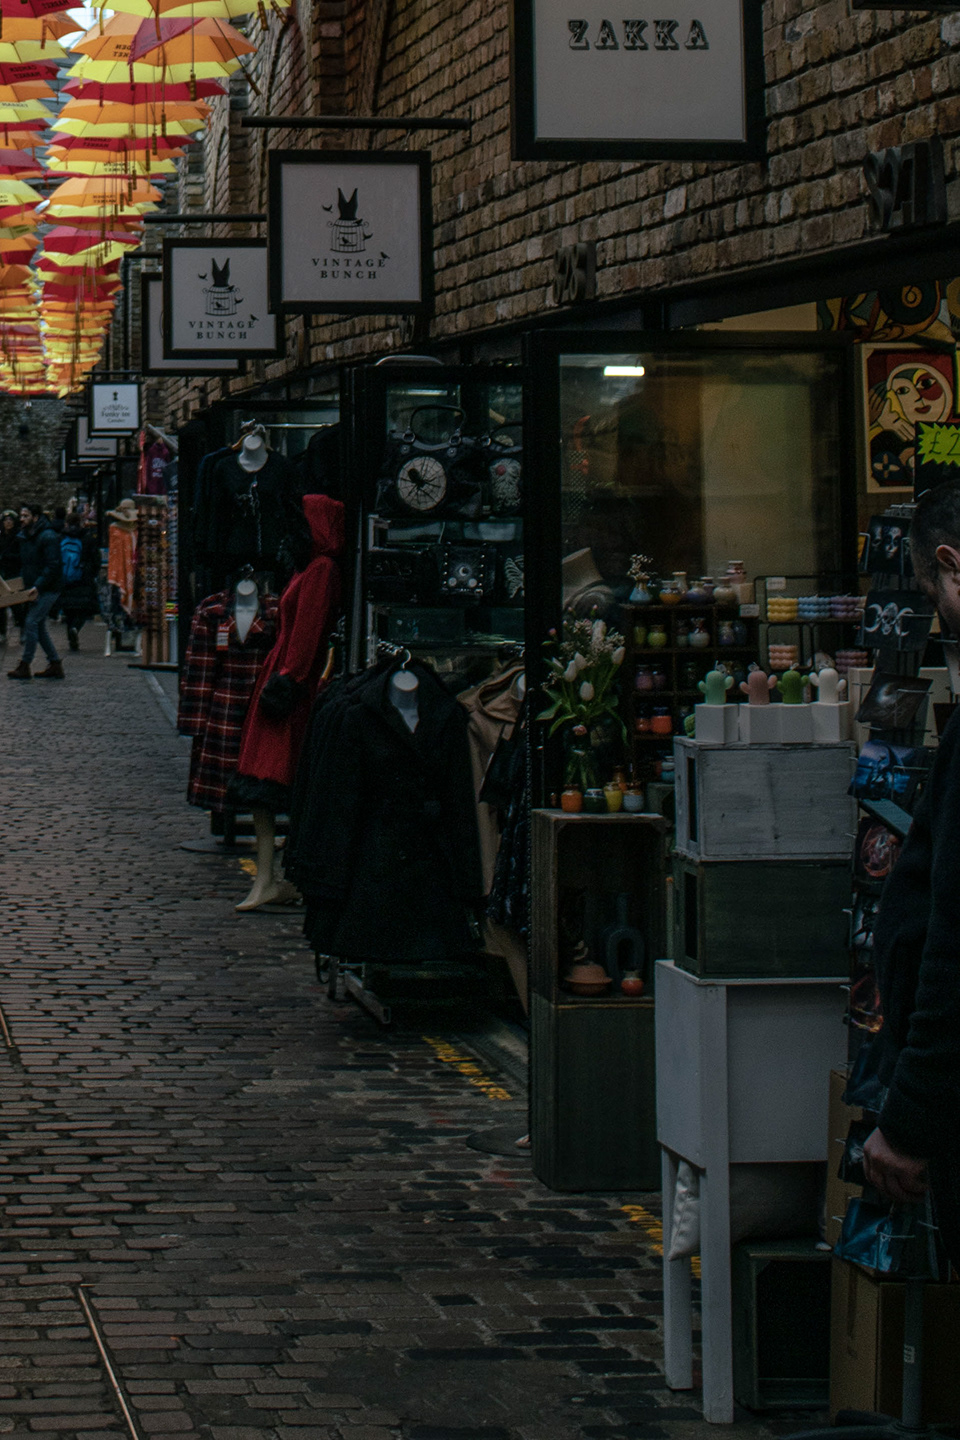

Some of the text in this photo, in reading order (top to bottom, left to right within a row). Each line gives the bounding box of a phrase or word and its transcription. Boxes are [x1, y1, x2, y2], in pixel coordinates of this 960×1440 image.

[568, 19, 710, 51] ZAKKA
[312, 258, 386, 268] VINTAGE
[320, 270, 376, 279] BUNCH
[189, 321, 255, 329] VINTAGE
[197, 331, 247, 339] BUNCH
